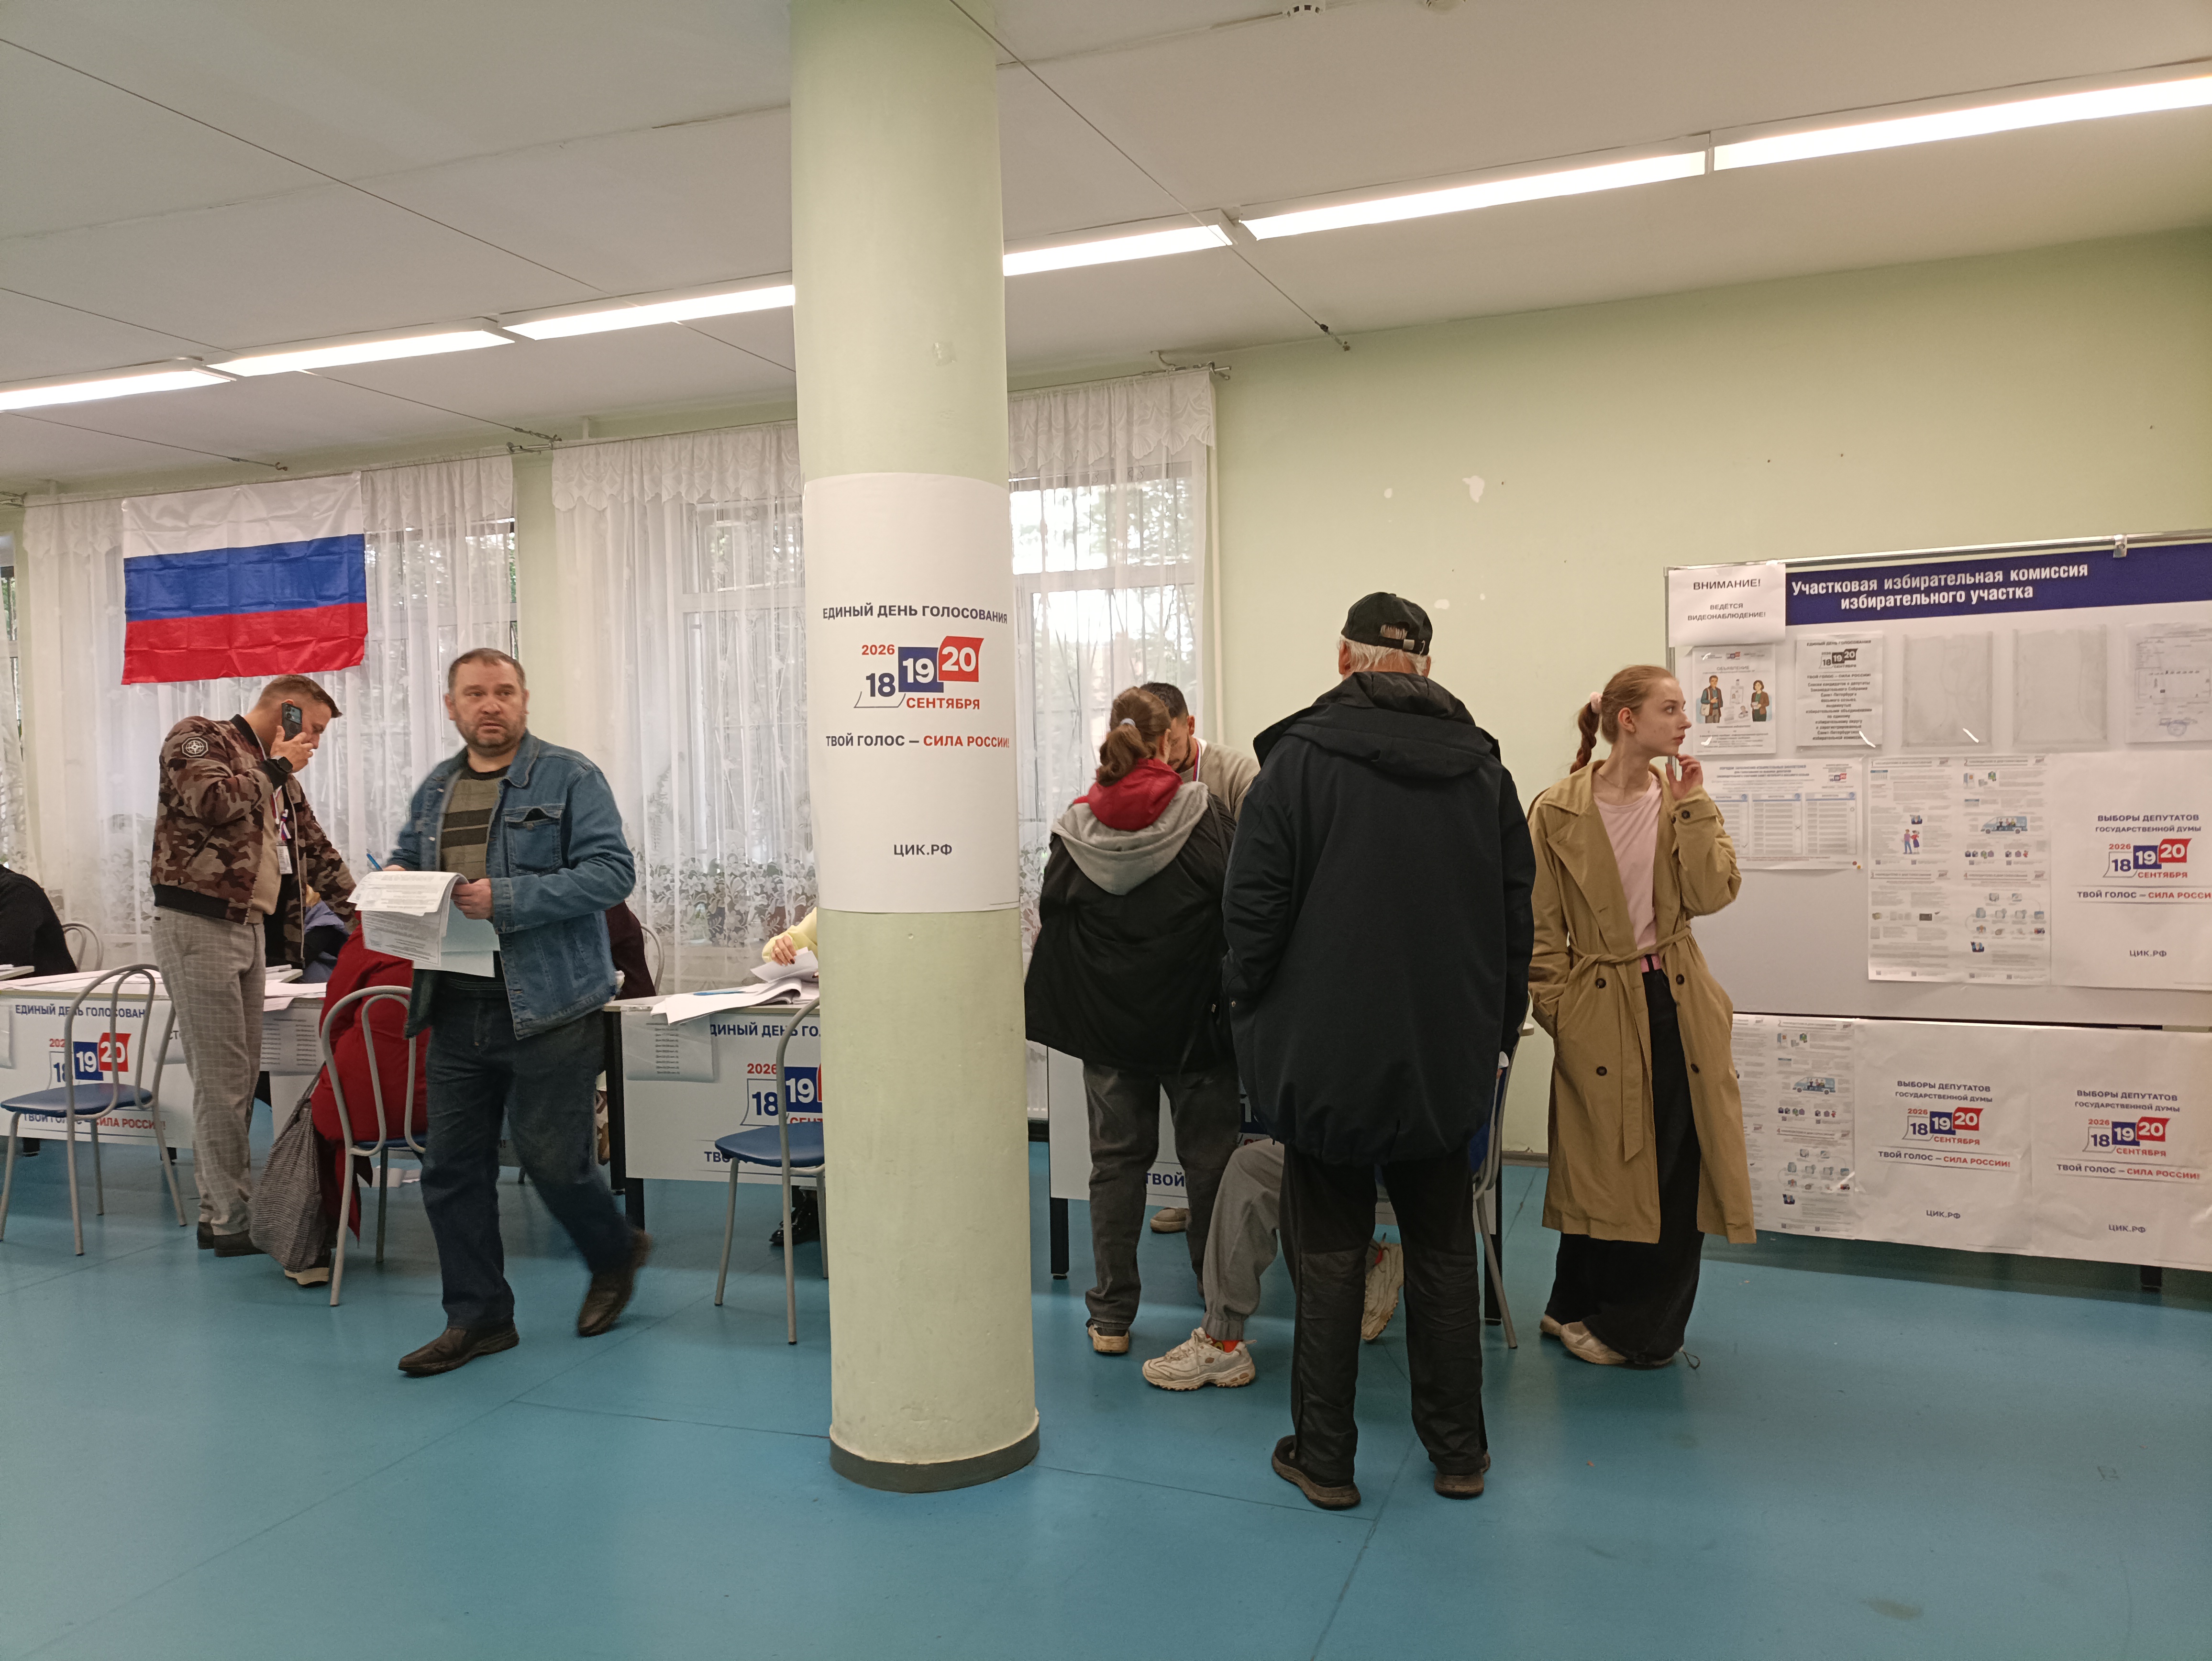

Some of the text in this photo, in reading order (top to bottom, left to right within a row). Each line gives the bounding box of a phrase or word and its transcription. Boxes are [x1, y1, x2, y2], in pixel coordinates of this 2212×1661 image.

[1693, 579, 1760, 590] ВНИМАНИЕ!
[1792, 564, 2088, 596] Участковая избирательная комиссия
[1841, 586, 2033, 610] избирательного участка
[823, 603, 1007, 624] ЕДИНЫЙ ДЕНЬ ГОЛОСОВАНИЯ
[1688, 612, 1766, 621] ВИДЕОНАБЛЮДЕНИЕ!
[862, 644, 895, 655] 2026
[866, 646, 976, 697] 18 19 20
[907, 698, 980, 710] СЕНТЯБРЯ
[826, 733, 853, 746] ТВОЙ
[857, 735, 905, 746] ГОЛОС
[923, 735, 963, 746] СИЛА
[967, 736, 1010, 748] РОССИИ!
[894, 844, 952, 857] ЦИК.РФ
[2112, 843, 2185, 872] 18 19 20
[2077, 890, 2102, 898] ТВОЙ
[15, 1004, 145, 1018] ЕДИНЫЙ ДЕЬ ГОЛООВАН
[710, 1022, 758, 1036] ДИНЫЙ
[49, 1038, 65, 1048] 202
[76, 1051, 97, 1073] 19
[100, 1041, 125, 1063] 20
[747, 1063, 776, 1074] 2026
[1897, 1081, 1991, 1092] ВЫБОРЫ ДЕПУТАТОВ
[752, 1078, 815, 1116] 18 19
[1895, 1092, 1968, 1100] ГОСУДАРСТВЕННОЙ
[2077, 1090, 2178, 1101] ВЫБОРЫ ДЕПУТАТОВ
[2075, 1101, 2153, 1110] ГОСУДАРСТВЕННОЙ
[122, 1118, 166, 1130] РОССИ!
[1910, 1112, 1978, 1135] 18 19 20
[2090, 1121, 2164, 1147] 18 19 20
[1934, 1136, 1980, 1145] СЕНТЯБРЯ
[2116, 1148, 2166, 1157] СЕНТЯБРЯ
[1970, 1158, 2010, 1167] РОССИИ!
[2057, 1163, 2081, 1172] ТВОЙ
[2085, 1165, 2116, 1174] ГОЛОС
[2156, 1170, 2201, 1180] РОССИИ!
[1146, 1172, 1184, 1187] ТВОЙ
[1926, 1210, 1960, 1218] ЦИК.РФ
[2109, 1224, 2146, 1233] ЦИК.РФ
